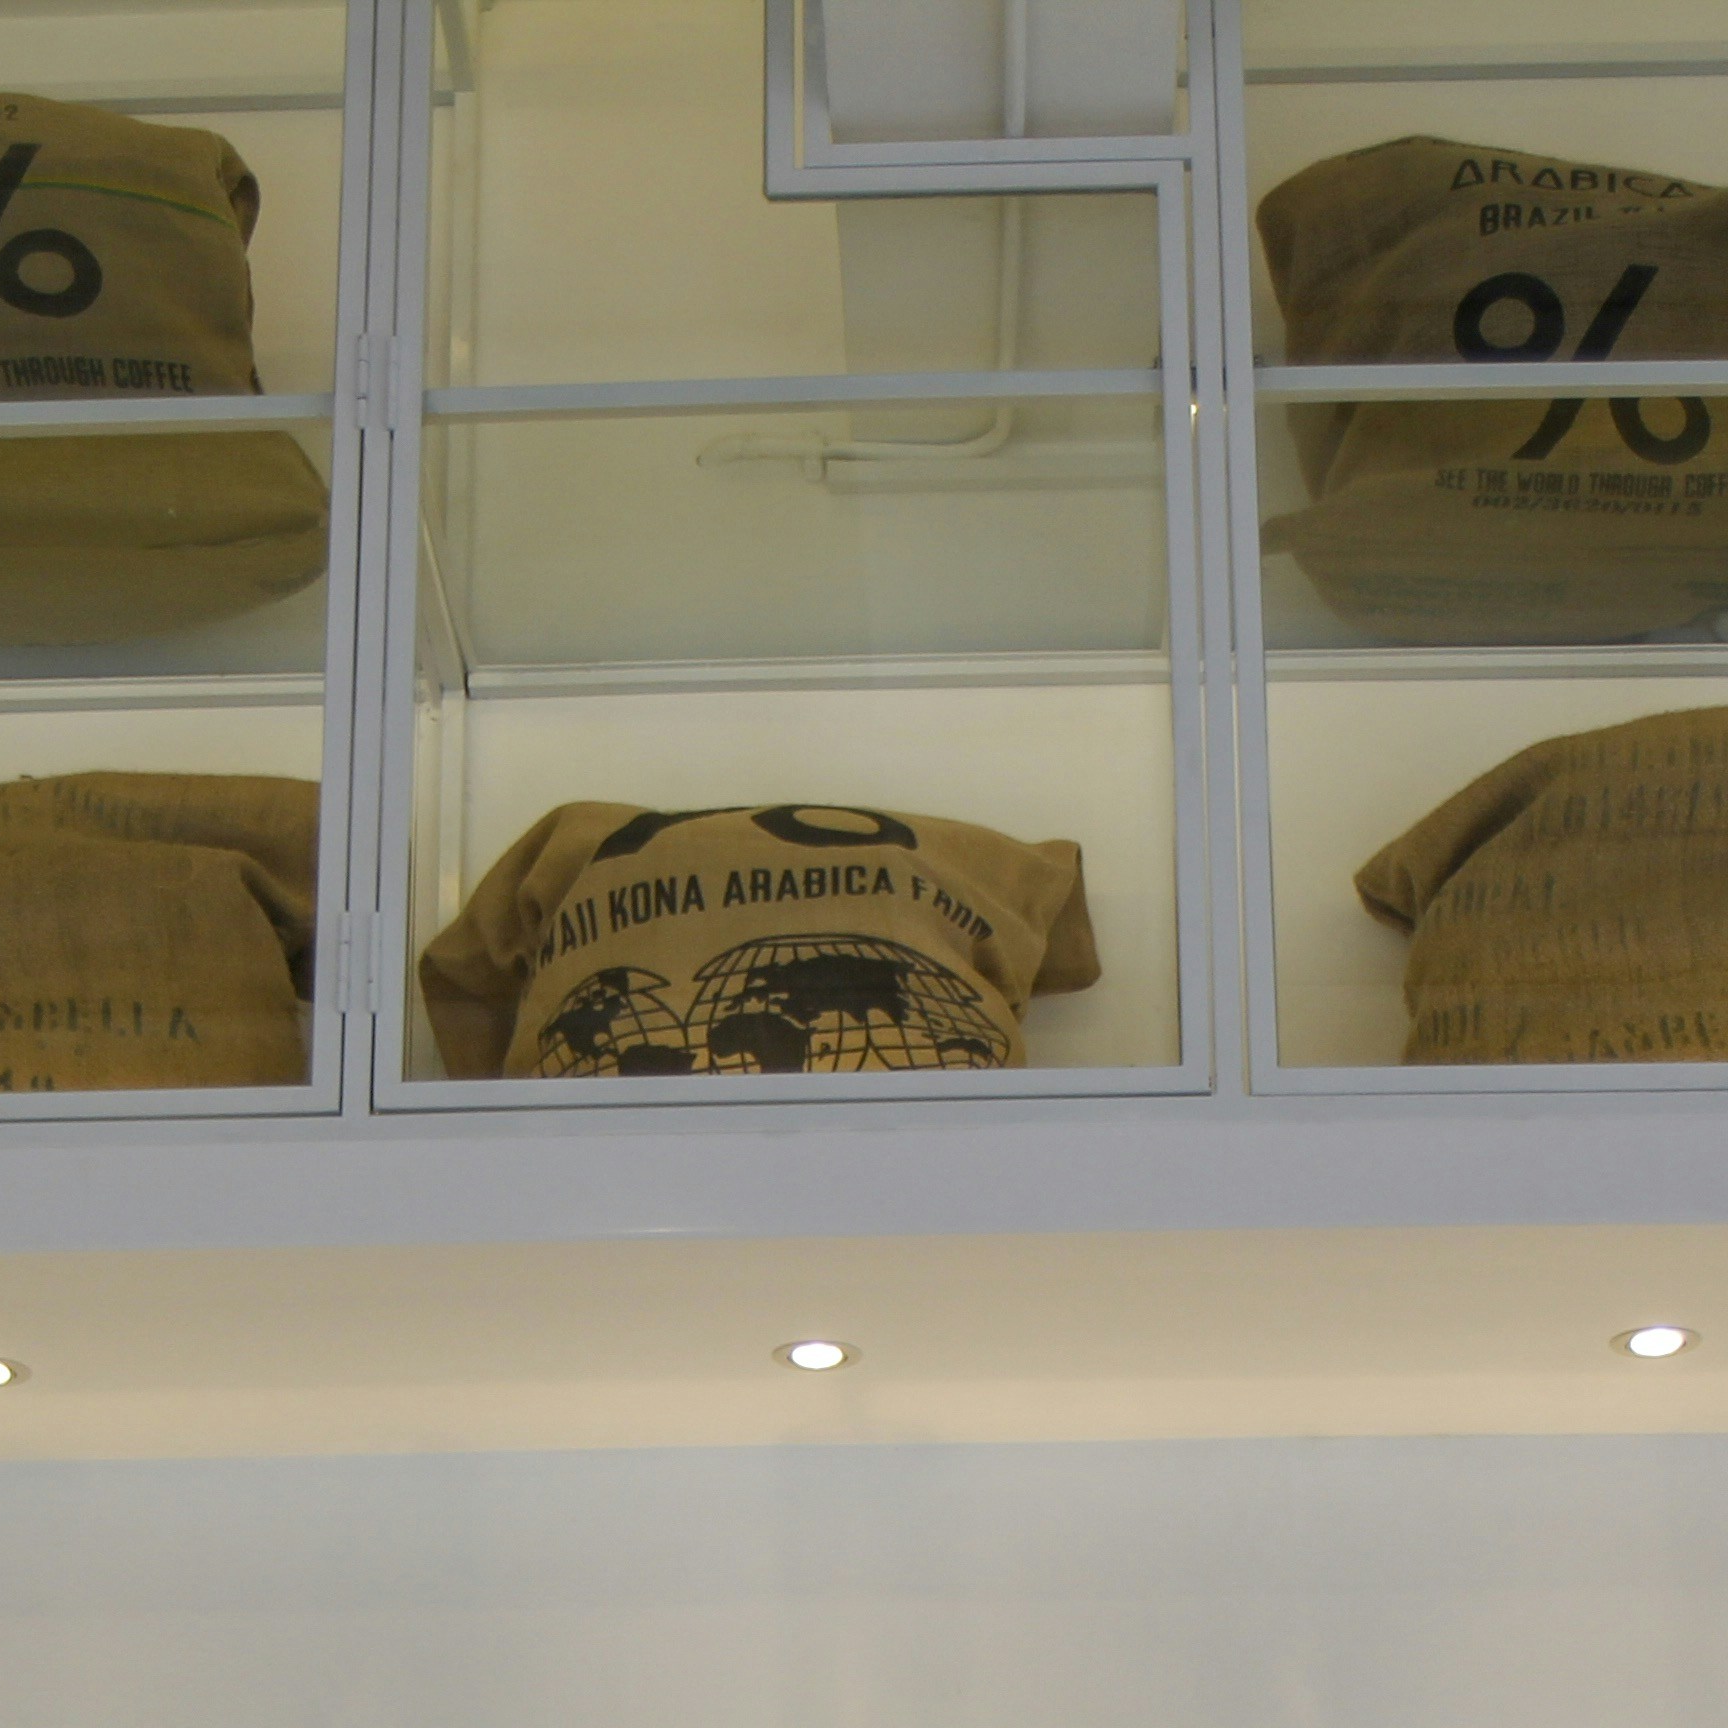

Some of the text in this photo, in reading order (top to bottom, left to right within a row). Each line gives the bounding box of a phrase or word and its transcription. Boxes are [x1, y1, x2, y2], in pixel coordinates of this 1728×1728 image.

[1450, 158, 1695, 198] ARABICA
[1479, 203, 1600, 237] BRAZIL
[112, 357, 195, 394] COFFEE
[1434, 469, 1468, 490] SEE
[1476, 469, 1509, 495] THE
[1517, 471, 1581, 498] WORLD
[1589, 472, 1673, 498] THROUGH
[608, 873, 705, 933] KONA
[722, 865, 895, 909] ARABICA
